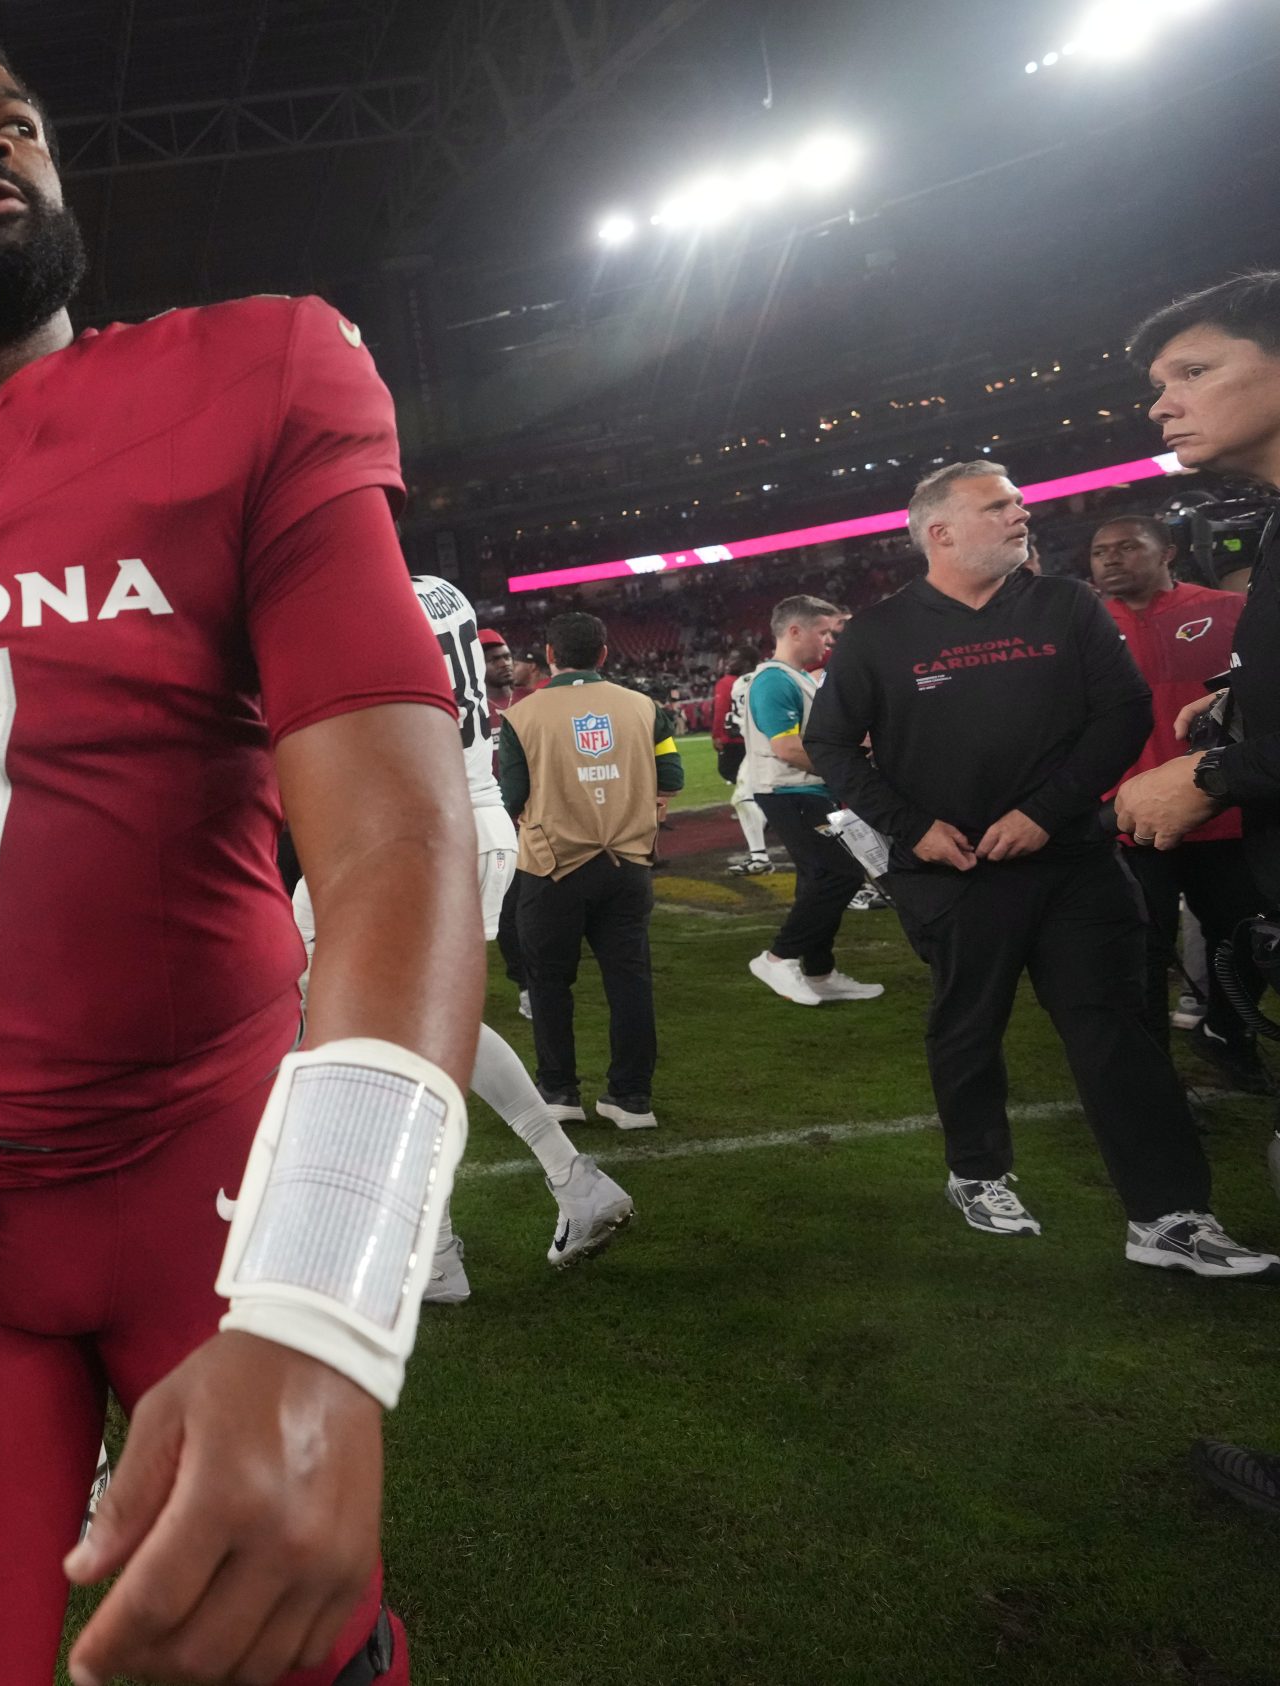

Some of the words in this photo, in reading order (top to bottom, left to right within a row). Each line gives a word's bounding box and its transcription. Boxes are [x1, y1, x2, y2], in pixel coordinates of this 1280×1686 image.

[939, 636, 1025, 659] ARIZONA
[912, 643, 1057, 676] CARDINALS
[580, 730, 609, 751] NFL
[577, 765, 620, 783] MEDIA
[594, 788, 606, 805] 9
